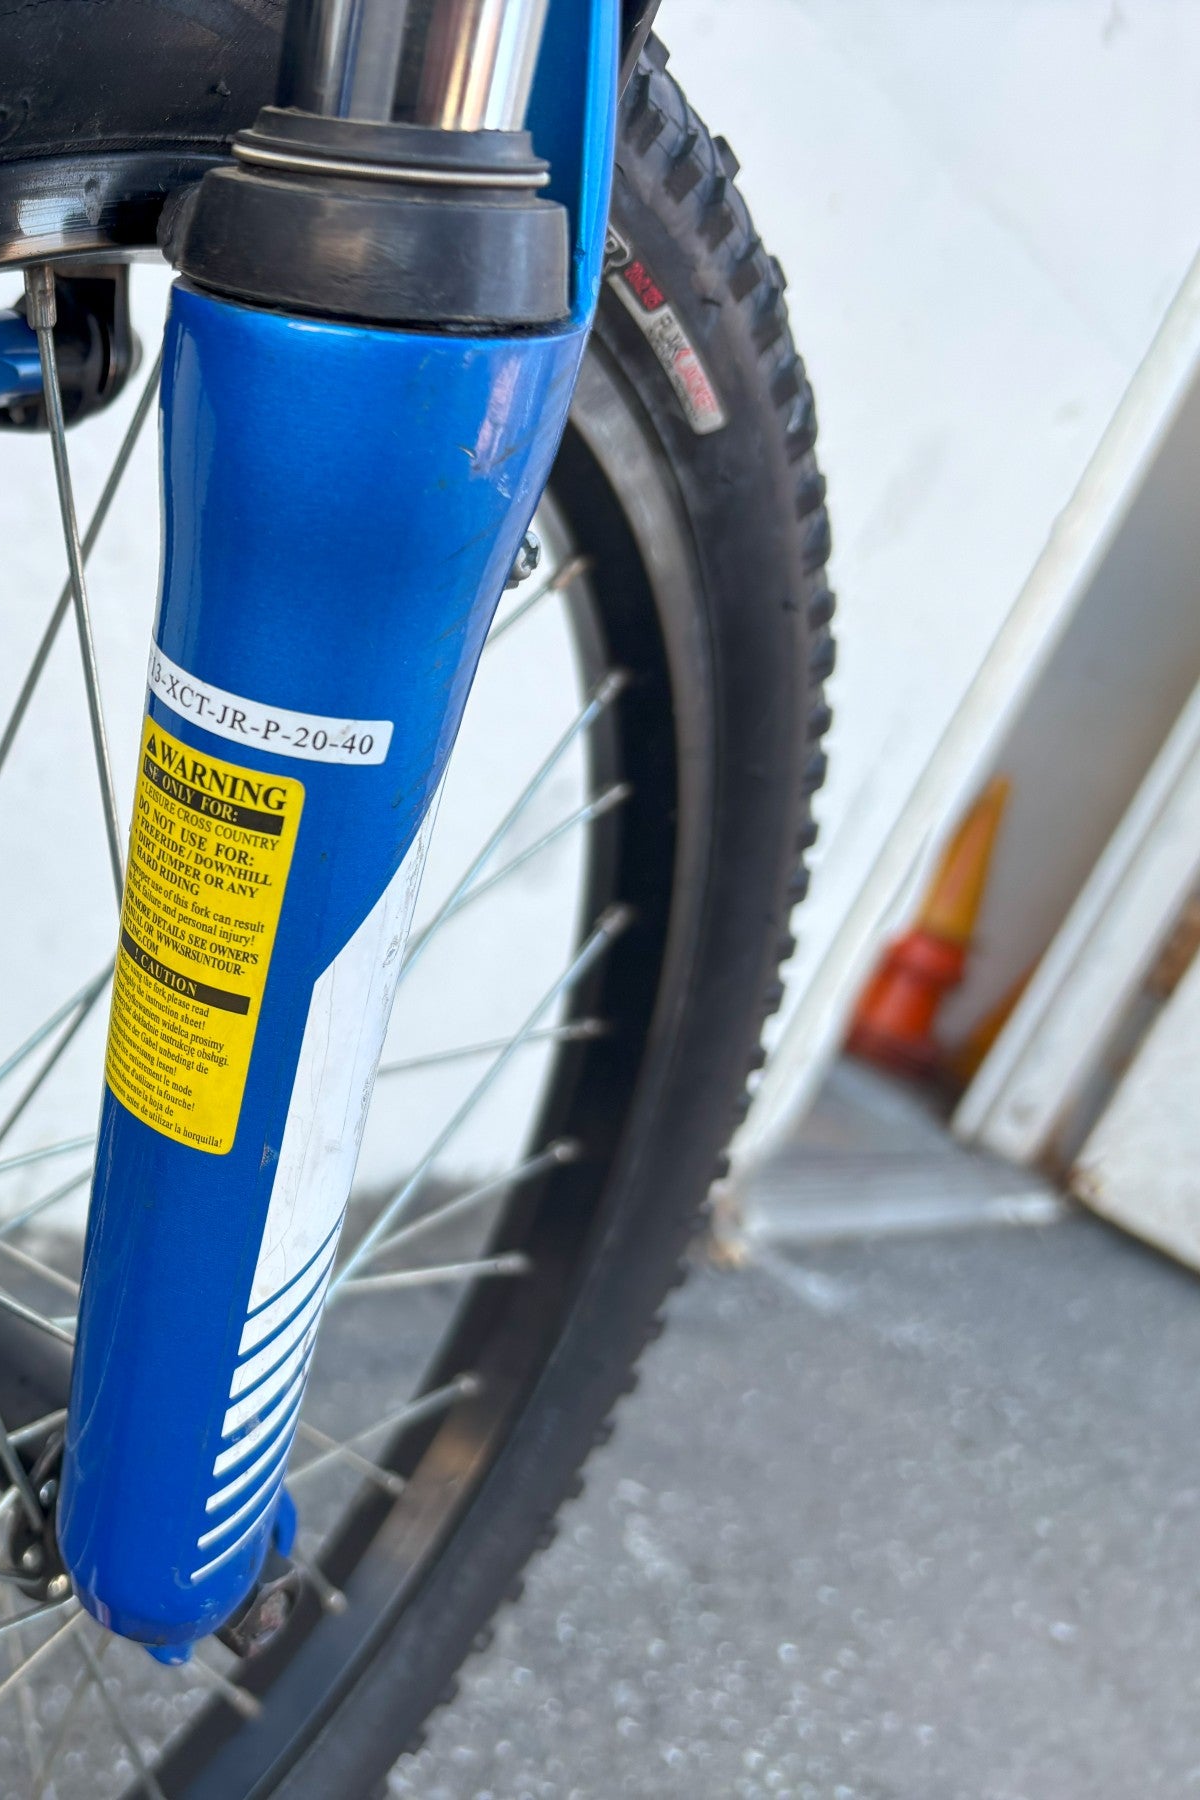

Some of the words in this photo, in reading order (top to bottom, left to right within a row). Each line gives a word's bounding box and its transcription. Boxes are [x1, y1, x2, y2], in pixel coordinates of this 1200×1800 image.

[144, 757, 162, 782] USE
[162, 775, 196, 804] ONLY
[201, 796, 239, 822] FOR:
[161, 740, 287, 811] WARNING
[138, 795, 150, 815] DO
[152, 810, 175, 835] NOT
[180, 827, 208, 851] USE
[215, 843, 254, 866] FOR:
[144, 784, 175, 814] LEISURE
[177, 807, 212, 832] CROSS
[214, 824, 279, 851] COUNTRY
[137, 832, 157, 855] DIRT
[157, 848, 201, 881] JUMPER
[204, 874, 224, 889] OR
[226, 882, 259, 899] ANY
[137, 844, 157, 871] HARD
[160, 868, 200, 896] RIDING
[140, 818, 186, 855] FREERIDE
[194, 854, 272, 886] DOWNHILL
[135, 893, 151, 917] MORE
[152, 908, 186, 940] DETAILS
[188, 934, 207, 951] SEE
[210, 942, 259, 965] OWNER'S
[142, 883, 162, 905] failure
[162, 901, 177, 918] and
[177, 913, 217, 936] personal
[219, 927, 255, 947] injury!
[144, 920, 154, 936] OR
[151, 881, 163, 895] use
[163, 888, 173, 900] of
[173, 894, 189, 909] this
[191, 902, 211, 919] fork
[213, 911, 231, 926] can
[234, 920, 265, 934] result
[141, 954, 197, 997] CAUTION
[144, 975, 152, 988] the
[167, 993, 190, 1010] please
[192, 1004, 210, 1017] read
[137, 983, 145, 995] the
[145, 991, 179, 1020] instruction
[181, 1013, 206, 1031] sheet!
[141, 1031, 158, 1051] Gabel
[159, 1048, 194, 1071] unbedingt
[196, 1062, 208, 1075] die
[162, 1018, 189, 1039] widelca
[191, 1033, 225, 1053] prosimy
[156, 1058, 176, 1075] lesen!
[164, 1076, 170, 1086] le
[172, 1082, 192, 1096] mode
[149, 1094, 163, 1113] hoja
[164, 1104, 174, 1116] de
[156, 1086, 163, 1097] la
[163, 1090, 195, 1112] fourche!
[140, 1105, 148, 1116] de
[148, 1110, 173, 1130] utilizar
[175, 1123, 181, 1134] la
[183, 1126, 222, 1148] horquilla!
